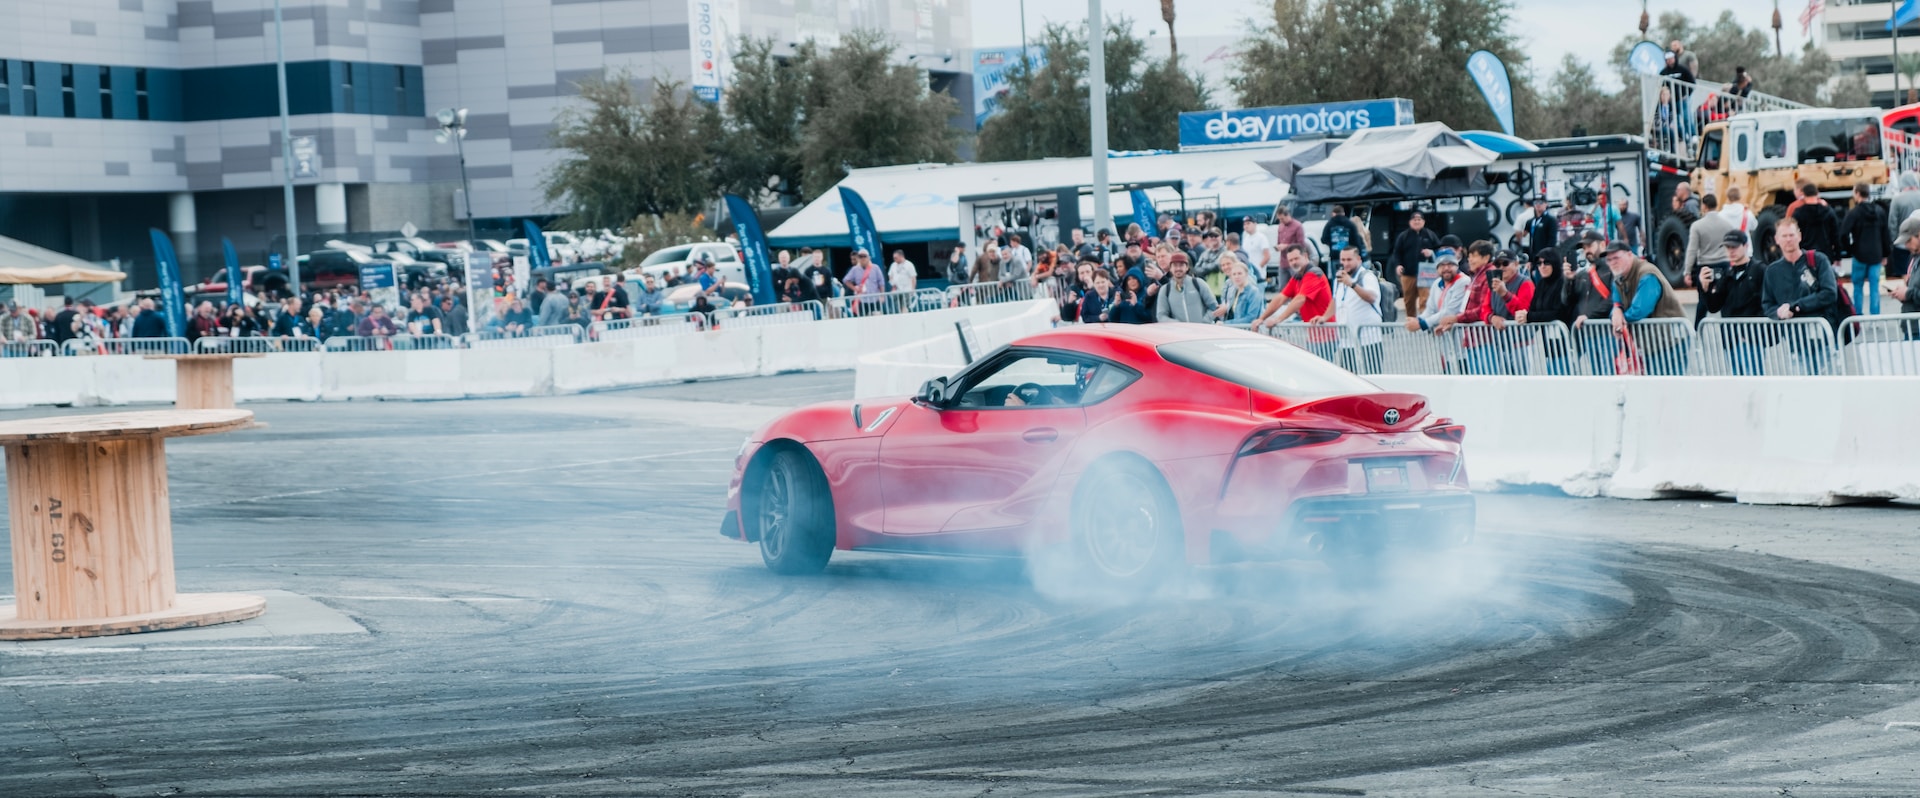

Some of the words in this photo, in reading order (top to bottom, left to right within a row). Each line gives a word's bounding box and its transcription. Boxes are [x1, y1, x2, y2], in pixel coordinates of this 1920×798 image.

[699, 2, 711, 35] PRO
[738, 223, 749, 247] Parts
[49, 497, 63, 524] AL
